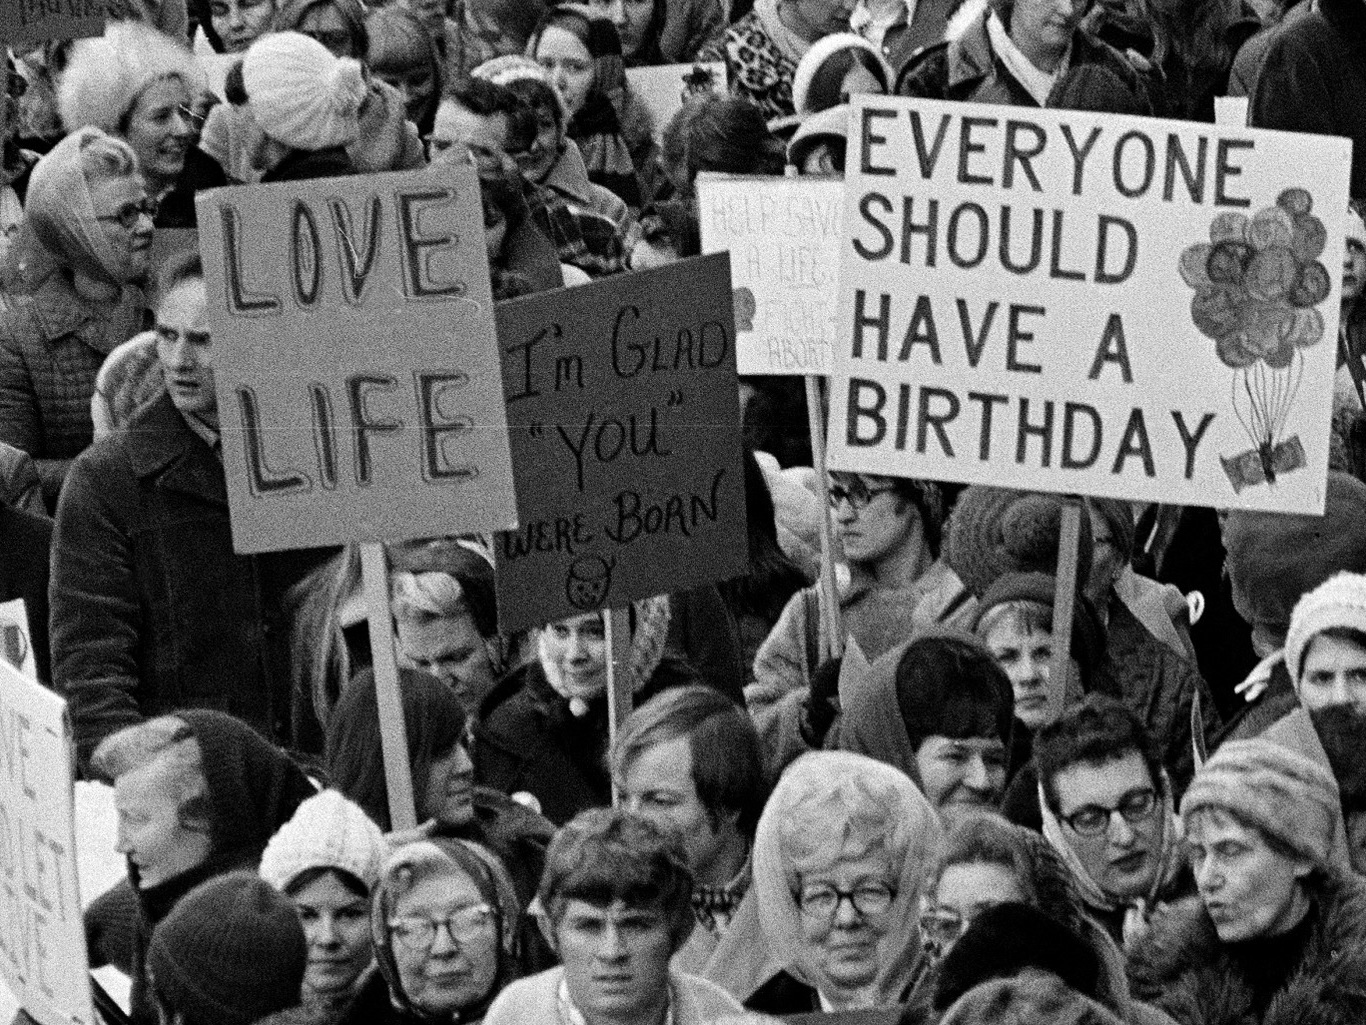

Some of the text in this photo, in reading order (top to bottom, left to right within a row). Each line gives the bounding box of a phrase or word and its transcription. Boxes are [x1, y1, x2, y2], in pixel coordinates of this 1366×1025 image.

[860, 106, 1256, 209] EVERYONE
[219, 187, 467, 315] LOVE
[851, 191, 1138, 286] SHOULD
[611, 305, 728, 376] GLAD
[851, 288, 1134, 384] HAVE A
[236, 371, 480, 498] LIFE
[845, 377, 1218, 481] BIRTHDAY
[503, 512, 593, 561] WERE
